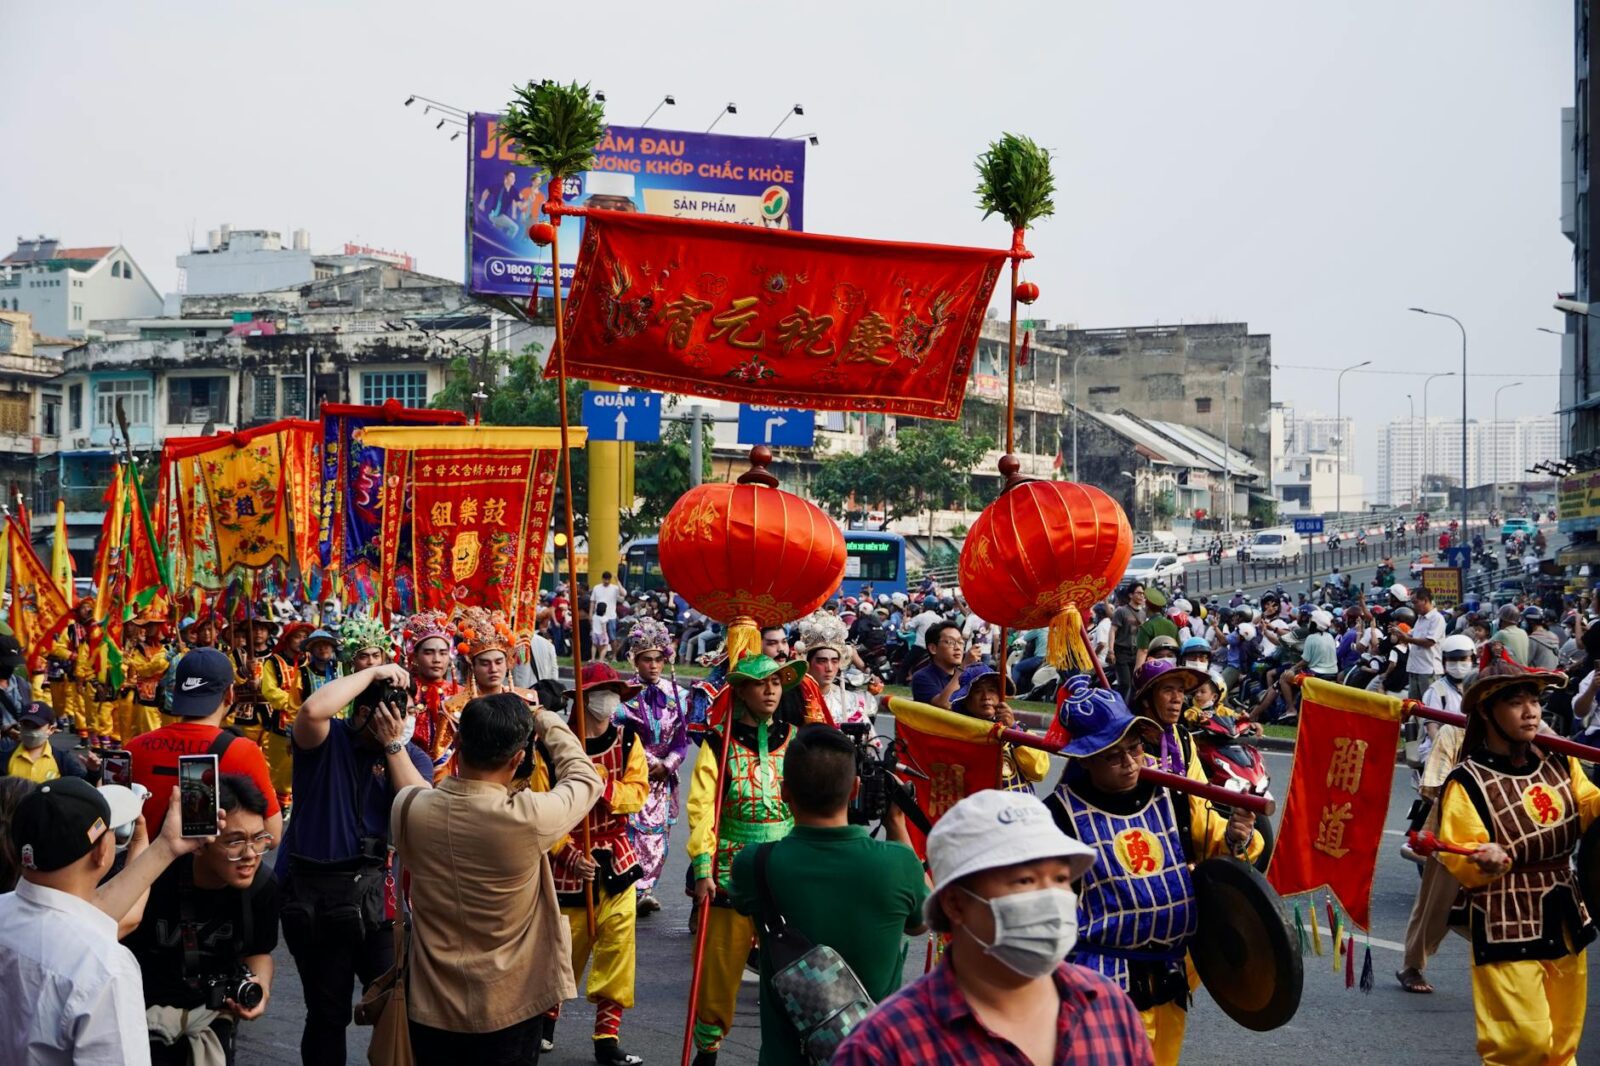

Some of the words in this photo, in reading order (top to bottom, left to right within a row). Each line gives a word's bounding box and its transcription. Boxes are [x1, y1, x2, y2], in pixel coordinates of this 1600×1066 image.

[480, 121, 526, 161] JE
[640, 138, 685, 156] ĐAU
[592, 155, 641, 173] ƯƠNG
[646, 158, 694, 176] KHỚP
[698, 160, 743, 181] CHẮC
[673, 196, 697, 210] SẢN
[701, 197, 736, 213] PHẨM
[506, 263, 532, 275] 1800
[558, 268, 575, 278] 89
[593, 393, 636, 410] QUẬN
[643, 396, 651, 407] 1
[141, 737, 212, 754] RONALD
